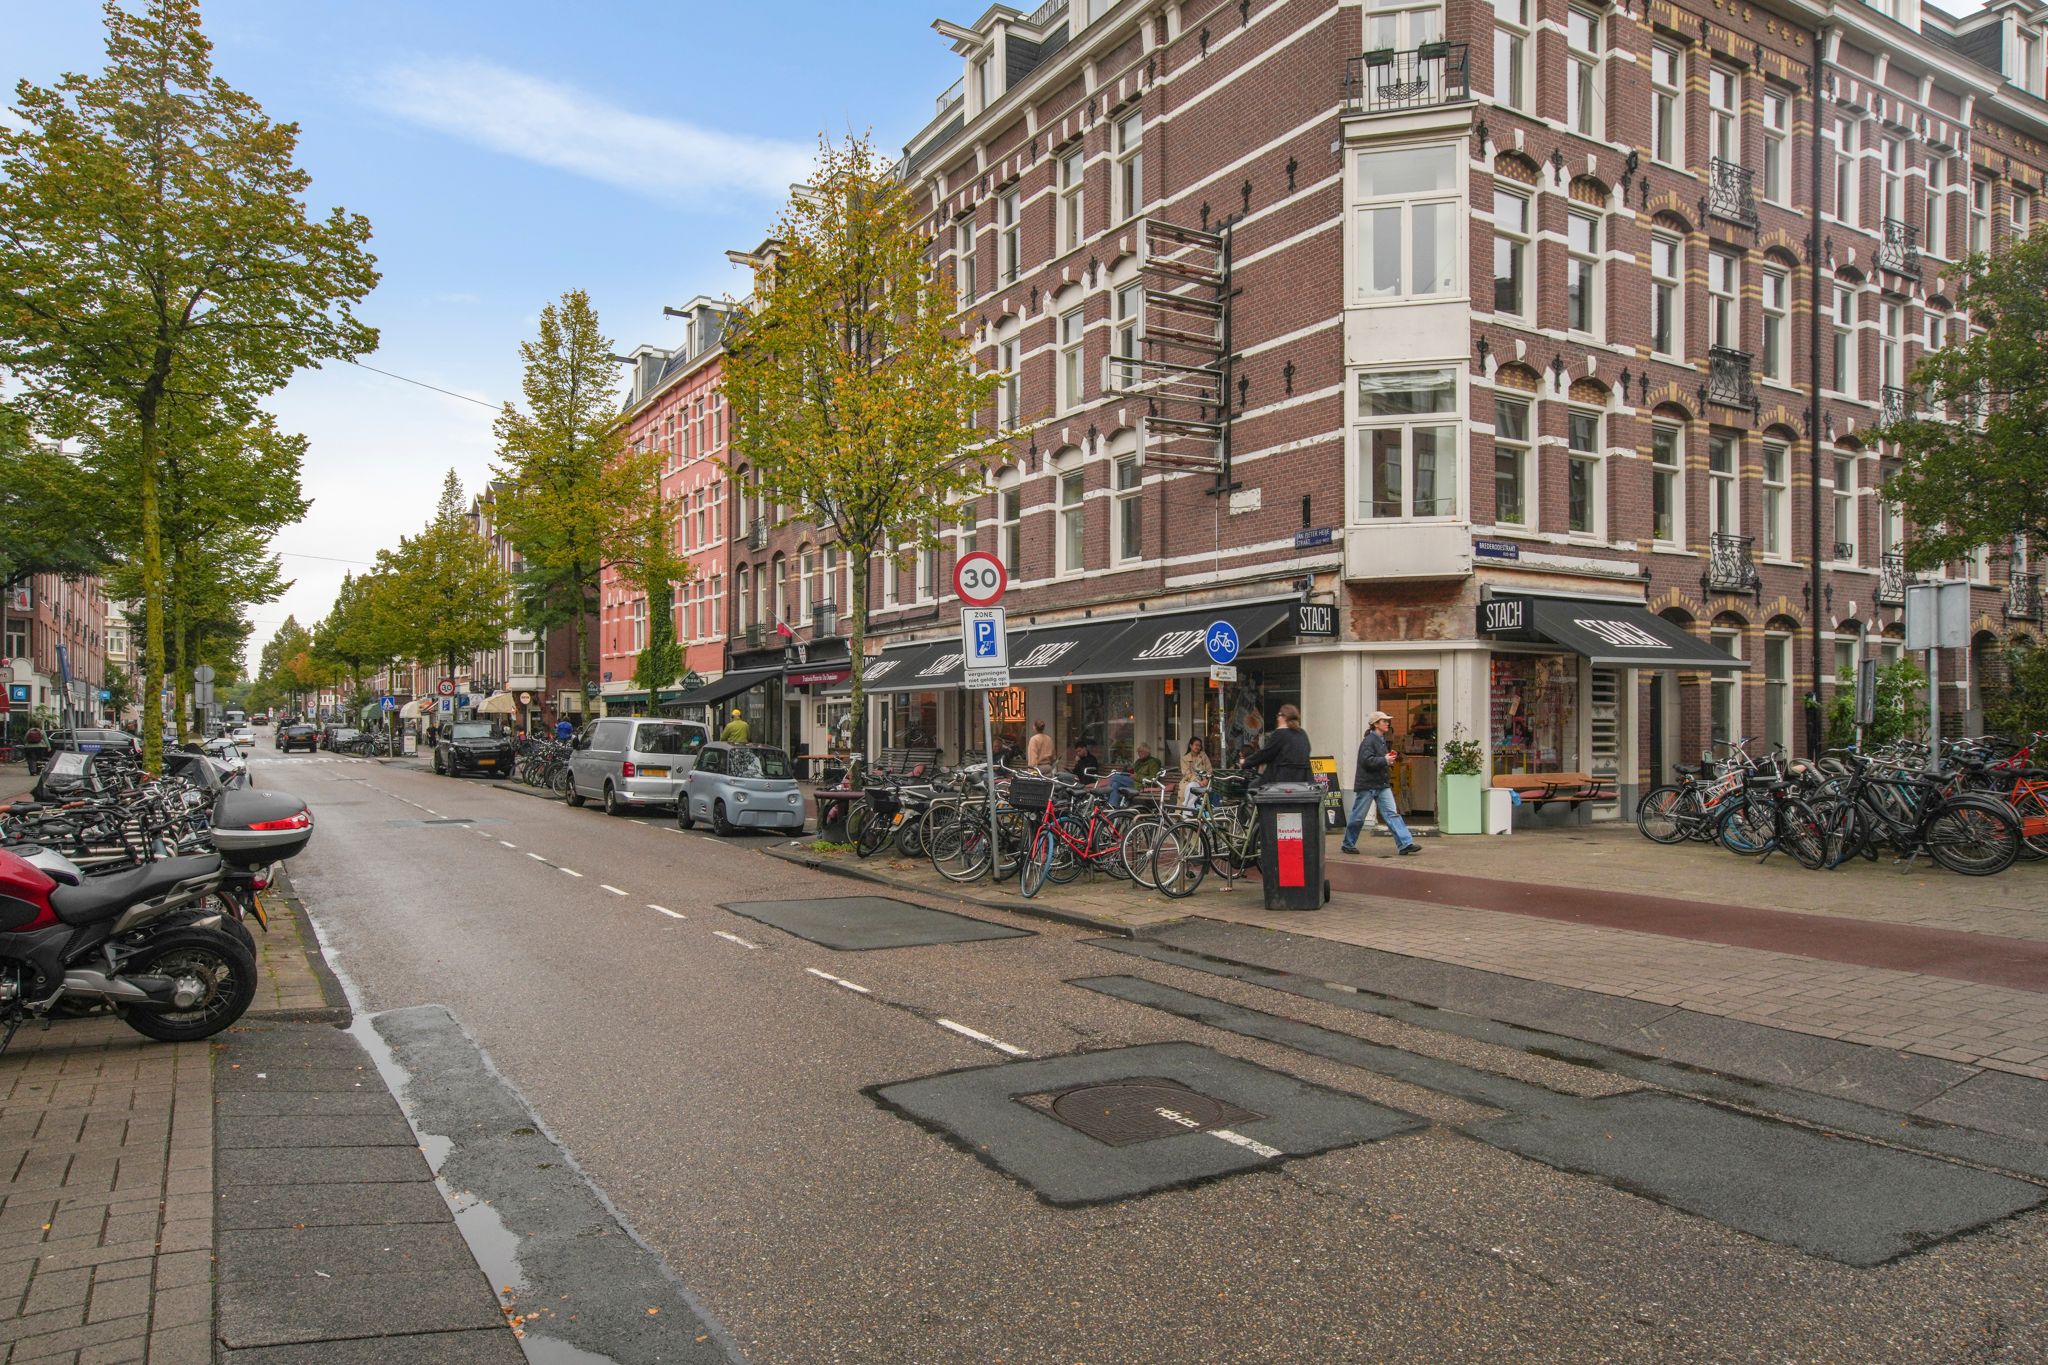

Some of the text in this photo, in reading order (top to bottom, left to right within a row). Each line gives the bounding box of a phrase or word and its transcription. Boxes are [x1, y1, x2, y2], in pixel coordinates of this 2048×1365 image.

[963, 568, 997, 589] 30
[1300, 606, 1331, 632] STACH
[1486, 601, 1522, 629] STACH
[1138, 629, 1207, 658] STACH
[1574, 619, 1668, 646] STACH
[1014, 640, 1080, 667] STACH
[968, 670, 1007, 678] vergunningen
[988, 690, 1026, 717] STACH
